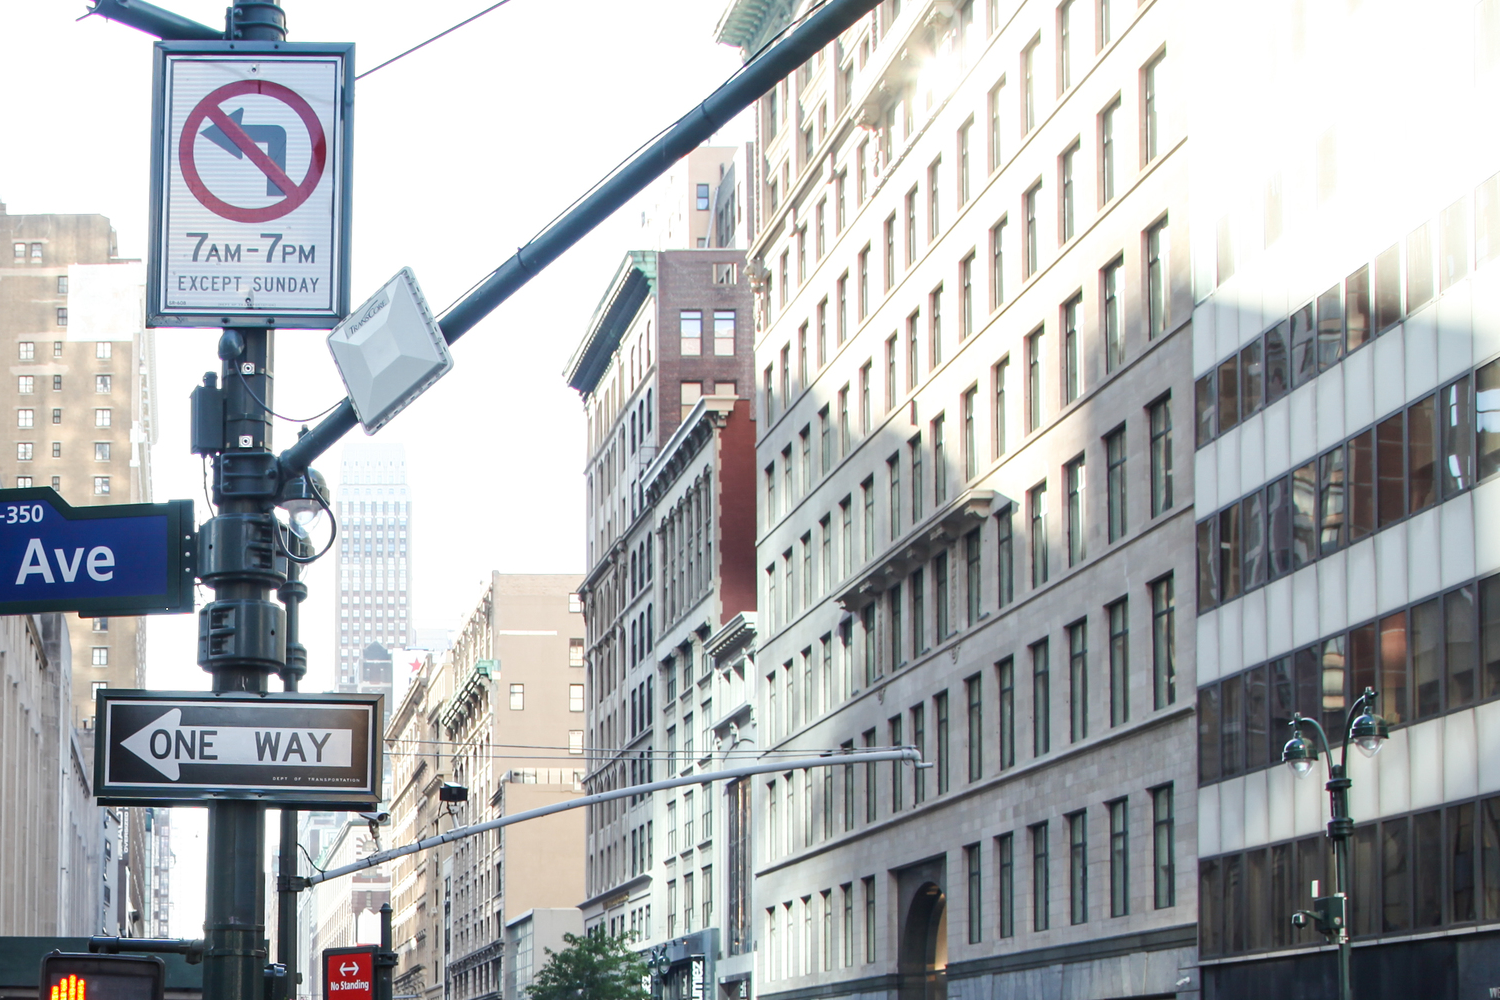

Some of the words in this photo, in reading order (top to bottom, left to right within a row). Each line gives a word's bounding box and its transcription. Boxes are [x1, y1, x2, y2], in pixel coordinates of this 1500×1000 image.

[178, 275, 242, 292] EXCEPT
[253, 277, 319, 294] SUNDAY
[6, 504, 44, 525] 350
[15, 538, 115, 584] Ave
[149, 729, 218, 761] ONE
[255, 732, 332, 763] WAY
[330, 981, 340, 991] No
[340, 979, 370, 992] Standing
